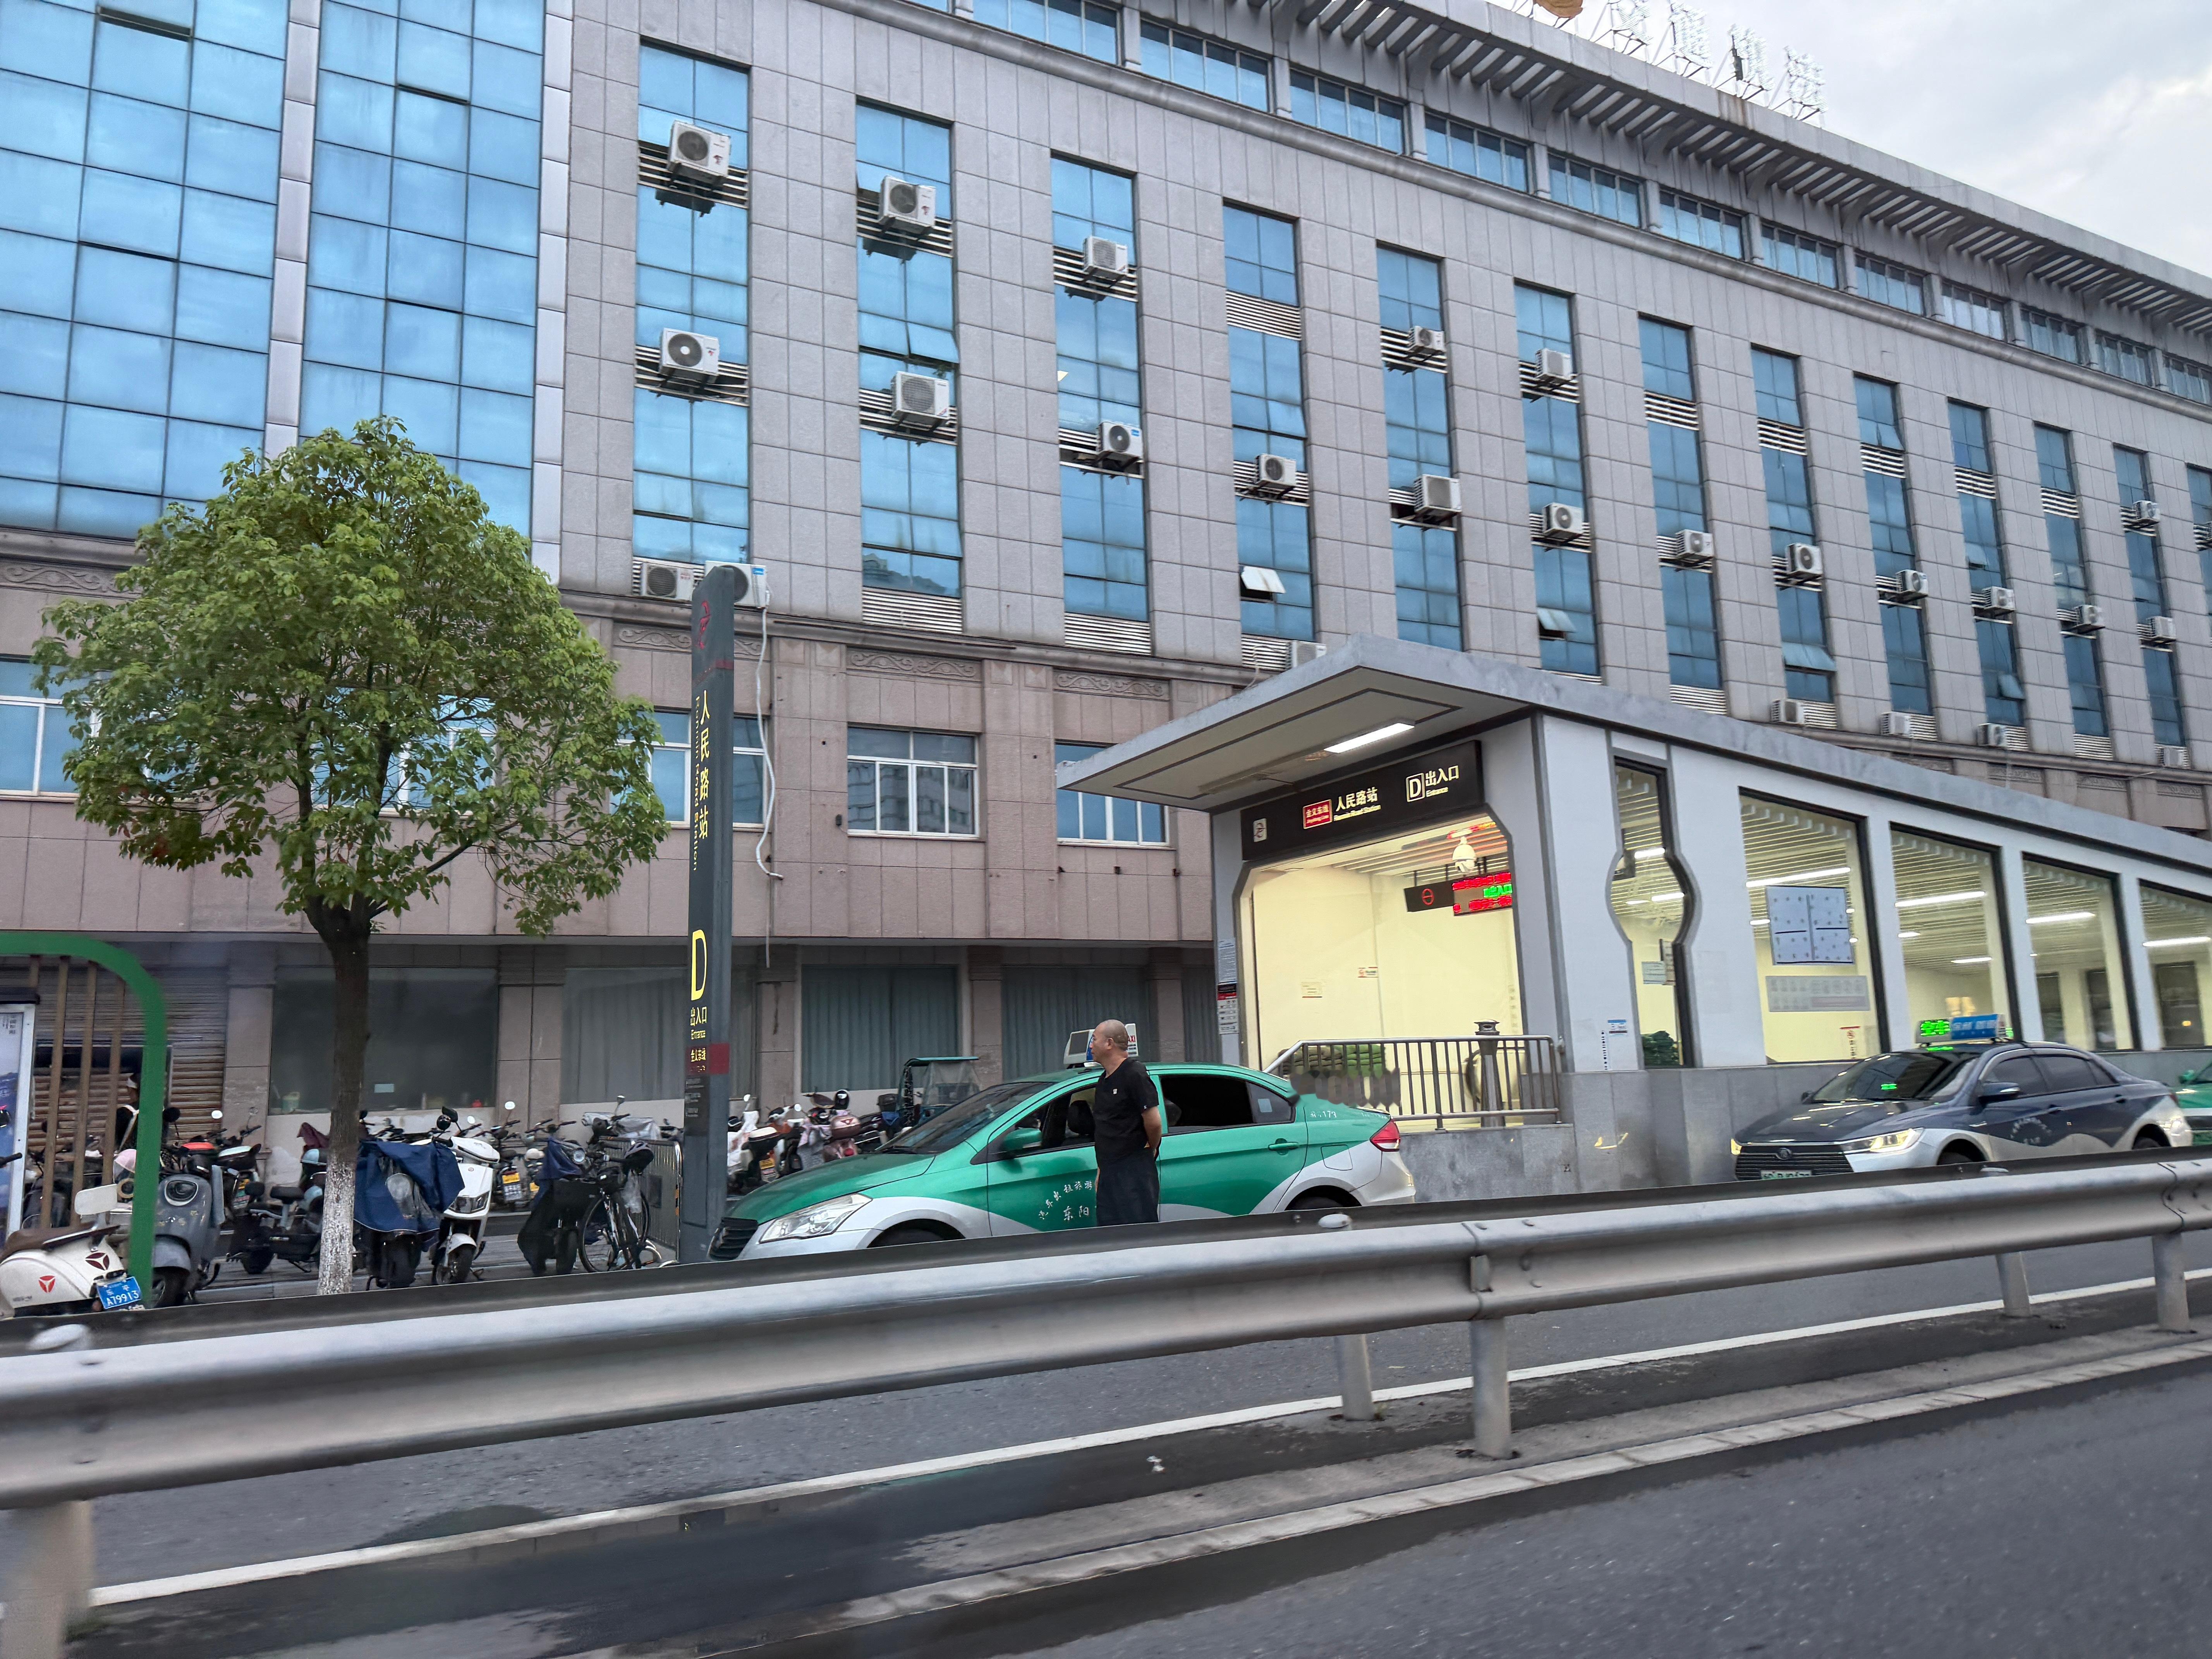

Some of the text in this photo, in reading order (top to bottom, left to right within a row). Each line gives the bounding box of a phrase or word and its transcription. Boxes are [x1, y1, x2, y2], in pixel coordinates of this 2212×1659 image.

[699, 690, 711, 839] 人民路站
[1425, 765, 1459, 787] 出入口
[1409, 778, 1421, 798] D
[1336, 787, 1378, 812] 人民路站
[691, 929, 708, 1001] D
[690, 1006, 707, 1026] 出入口
[106, 1290, 139, 1306] A79913
